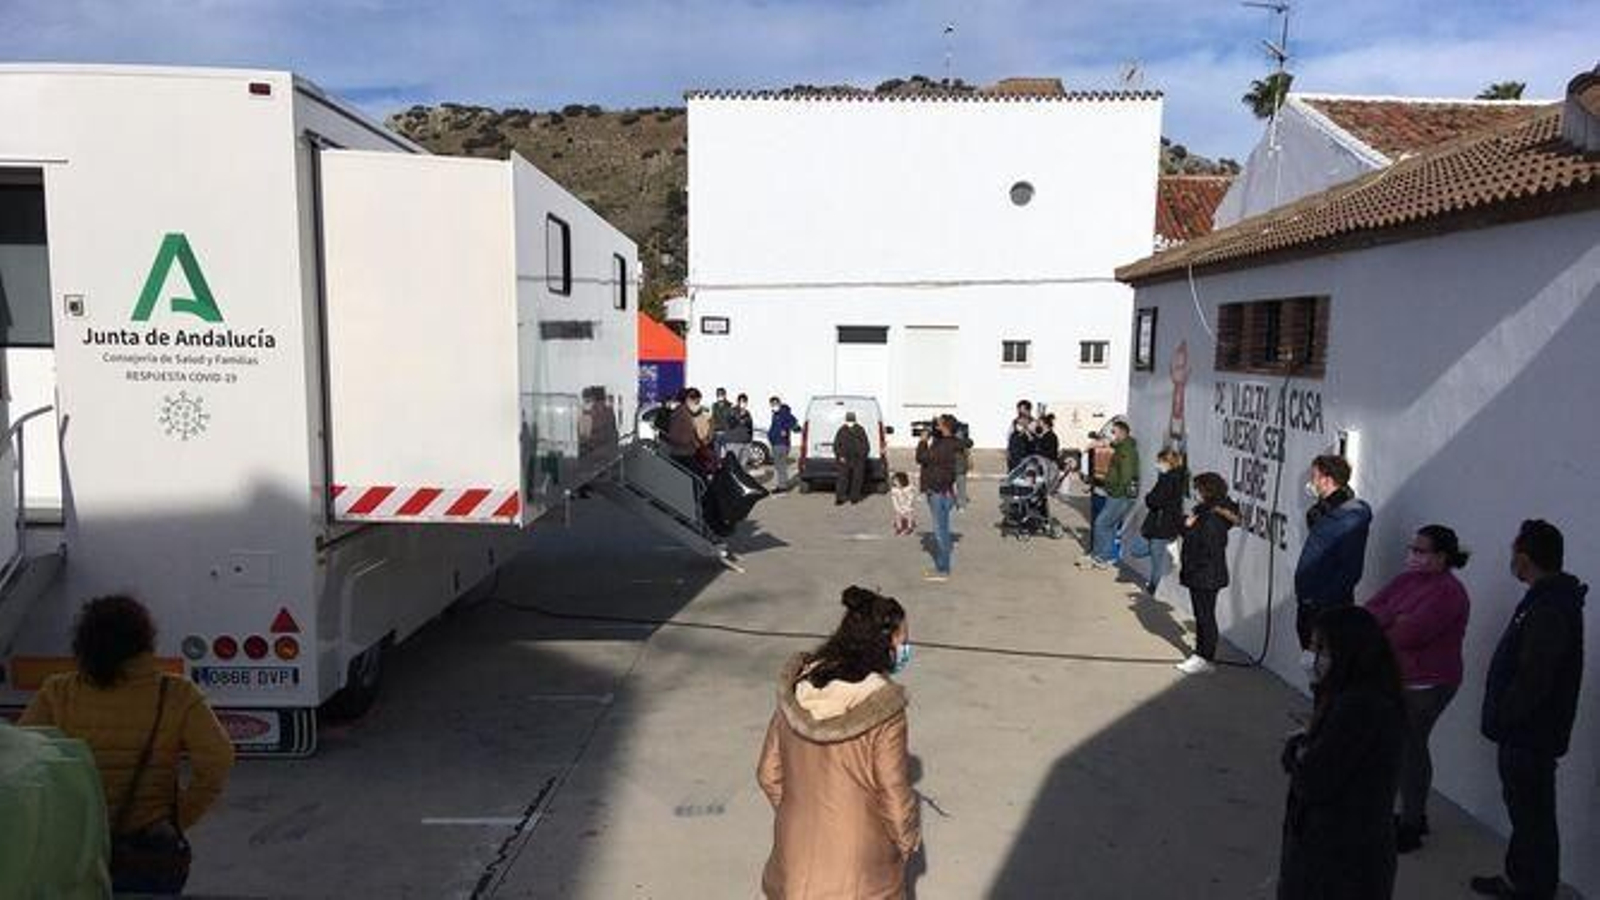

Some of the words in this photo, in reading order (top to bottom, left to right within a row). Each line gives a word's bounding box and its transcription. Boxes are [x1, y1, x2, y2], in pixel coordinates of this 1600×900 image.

[83, 328, 140, 346] Junta
[145, 329, 170, 346] de
[175, 328, 276, 348] Andalucía
[160, 353, 172, 363] de
[175, 353, 205, 364] Salud
[206, 355, 213, 366] y
[215, 354, 259, 365] Familias
[126, 371, 187, 382] RESPUESTA
[1230, 382, 1269, 423] VUELTA
[1289, 389, 1324, 434] CASA
[1263, 426, 1286, 463] SER
[1232, 457, 1268, 502] LIBRE
[258, 670, 289, 685] DVP
